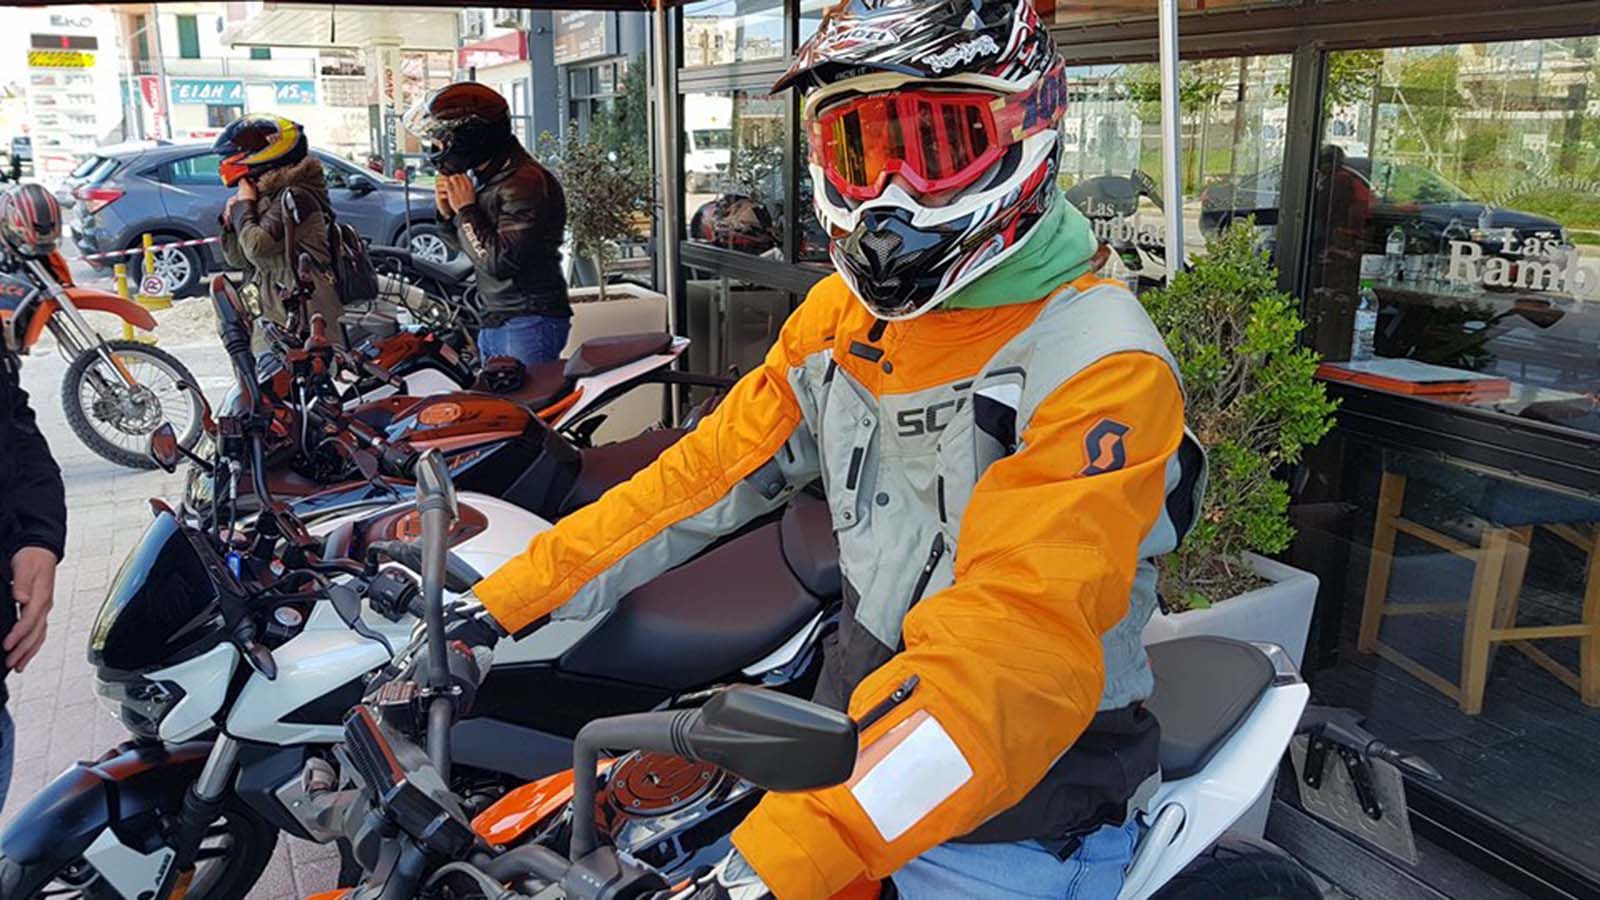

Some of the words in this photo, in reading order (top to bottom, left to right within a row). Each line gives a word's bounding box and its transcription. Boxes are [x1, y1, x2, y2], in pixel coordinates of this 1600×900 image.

[1086, 196, 1115, 217] Las
[1501, 227, 1560, 257] Las
[897, 397, 967, 437] SC
